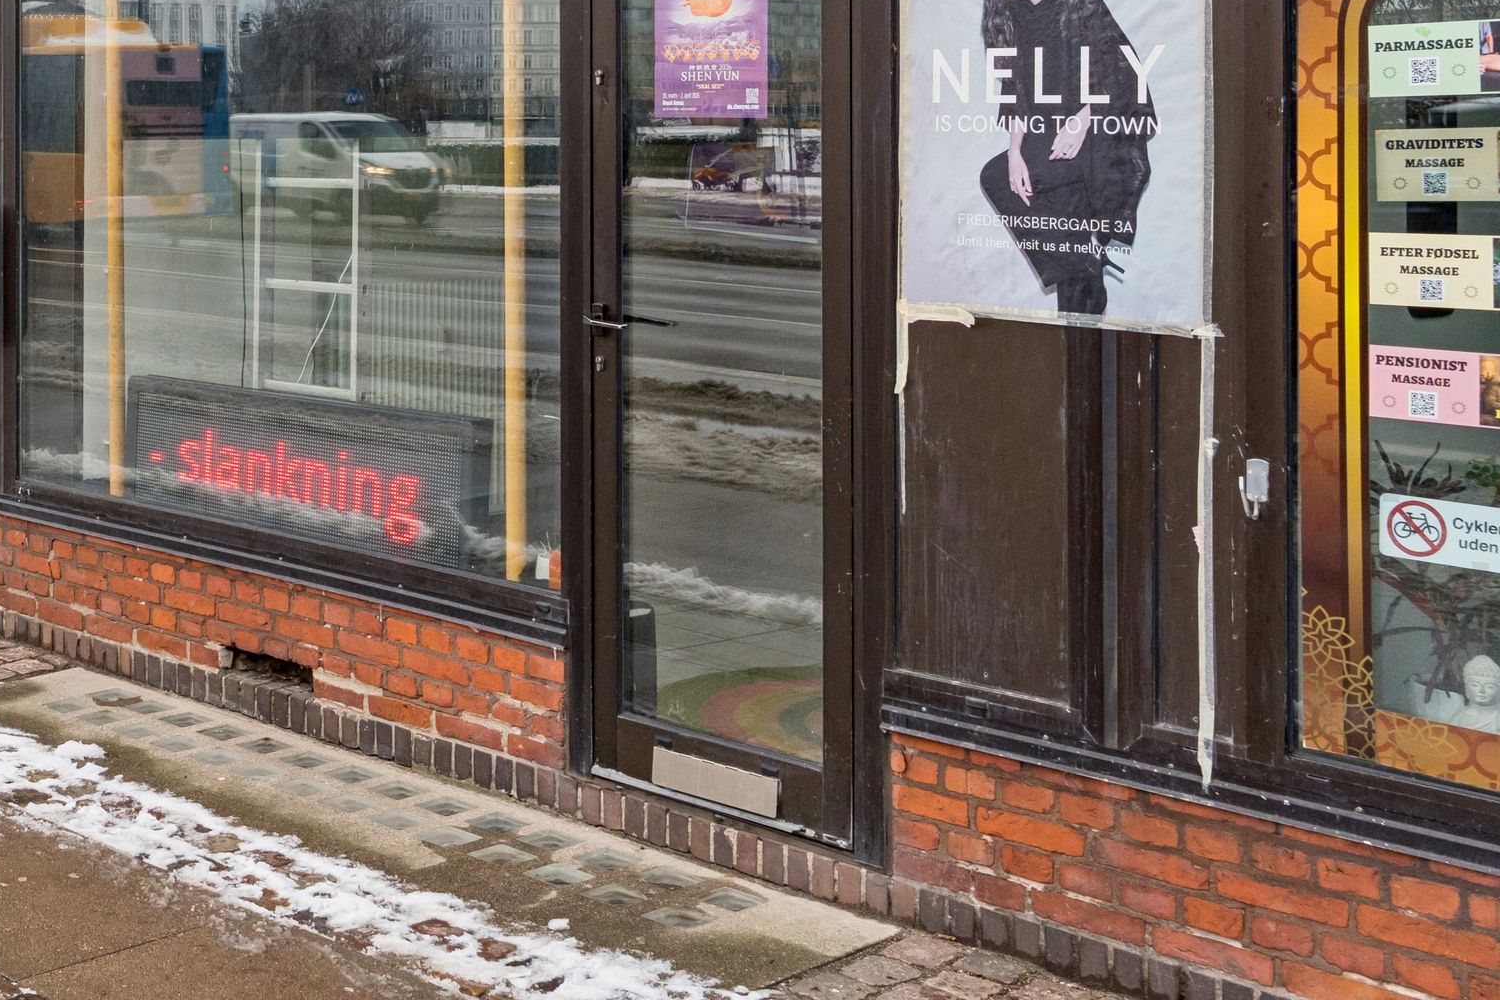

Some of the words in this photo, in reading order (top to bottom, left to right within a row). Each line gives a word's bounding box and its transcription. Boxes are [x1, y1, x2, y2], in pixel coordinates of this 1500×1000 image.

[1374, 37, 1474, 52] PARMASSAGE
[680, 70, 712, 82] SHEN
[715, 70, 740, 81] YUN
[932, 44, 1167, 104] NELLY
[935, 114, 950, 132] IS
[957, 114, 1045, 134] COMING
[1051, 115, 1082, 134] TO
[1089, 115, 1162, 135] TOWN
[1385, 138, 1484, 150] GRAVIDITETS
[1404, 158, 1465, 168] MASSAGE
[957, 213, 1110, 233] FREDERIKSBERGGADE
[1113, 220, 1134, 234] 3A
[957, 236, 982, 248] Until
[985, 238, 1014, 251] then,
[1016, 239, 1040, 251] visit
[1042, 243, 1056, 252] us
[1058, 242, 1070, 253] at
[1073, 243, 1132, 257] nelly.com
[1380, 246, 1424, 258] EFTER
[1426, 247, 1480, 260] FØDSEL
[1399, 265, 1459, 276] MASSAGE
[1375, 354, 1468, 372] PENSIONIST
[1391, 374, 1451, 387] MASSAGE
[176, 428, 420, 545] slankning
[1458, 539, 1499, 554] uden
